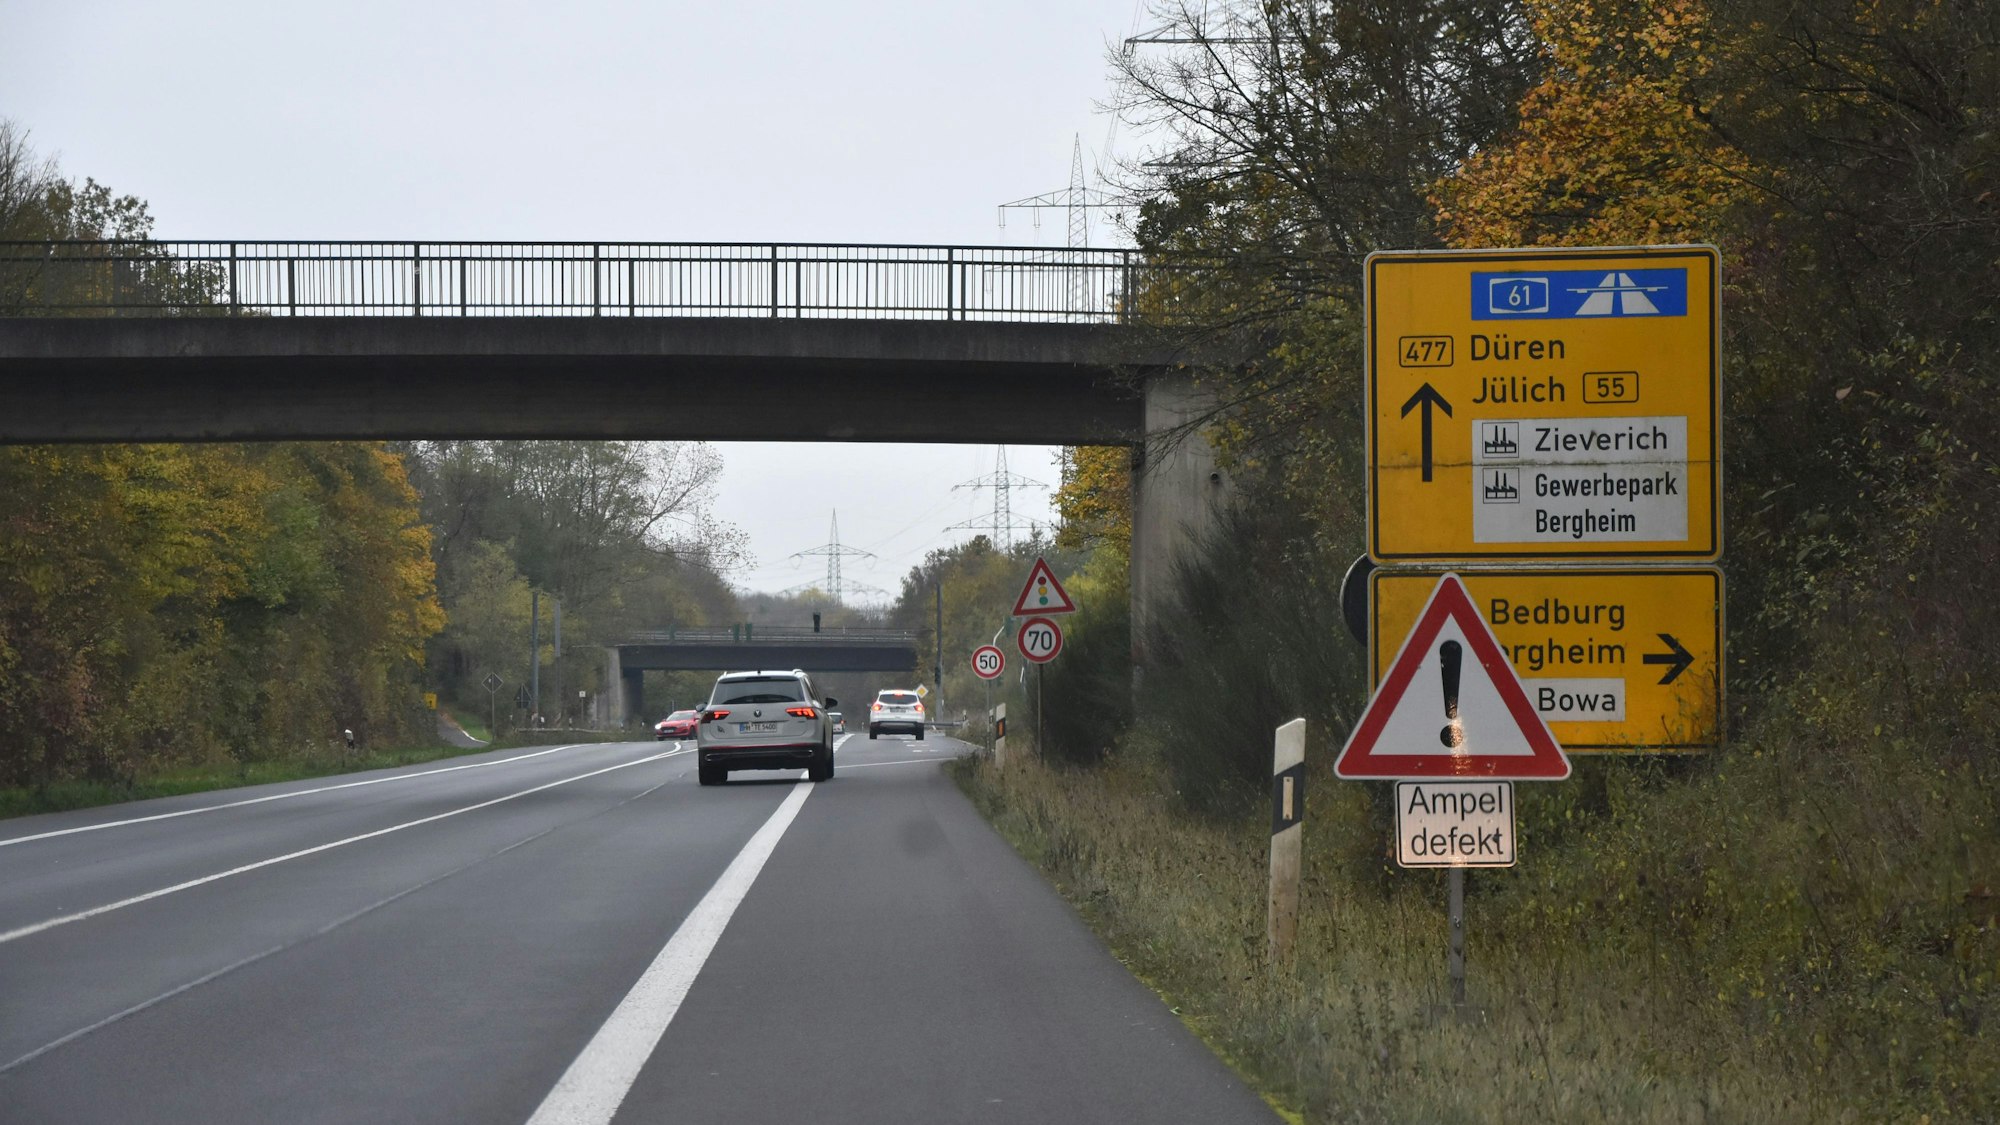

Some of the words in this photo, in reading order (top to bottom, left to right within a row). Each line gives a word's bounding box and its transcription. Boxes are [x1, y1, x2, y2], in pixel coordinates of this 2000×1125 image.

[1509, 286, 1529, 305] 61
[1405, 341, 1447, 362] 477
[1471, 334, 1564, 360] Düren
[1473, 376, 1564, 403] Jülich
[1598, 378, 1624, 397] 55
[1536, 426, 1667, 451] Zieverich
[1536, 471, 1678, 502] Gewerbepark
[1536, 508, 1635, 539] Bergheim
[1491, 598, 1624, 631] Bedburg
[1029, 631, 1052, 650] 70
[1501, 638, 1624, 671] rgheim
[980, 655, 997, 669] 50
[1539, 688, 1615, 711] Bowa
[1409, 785, 1502, 821] Ampel
[1411, 826, 1503, 856] defekt
